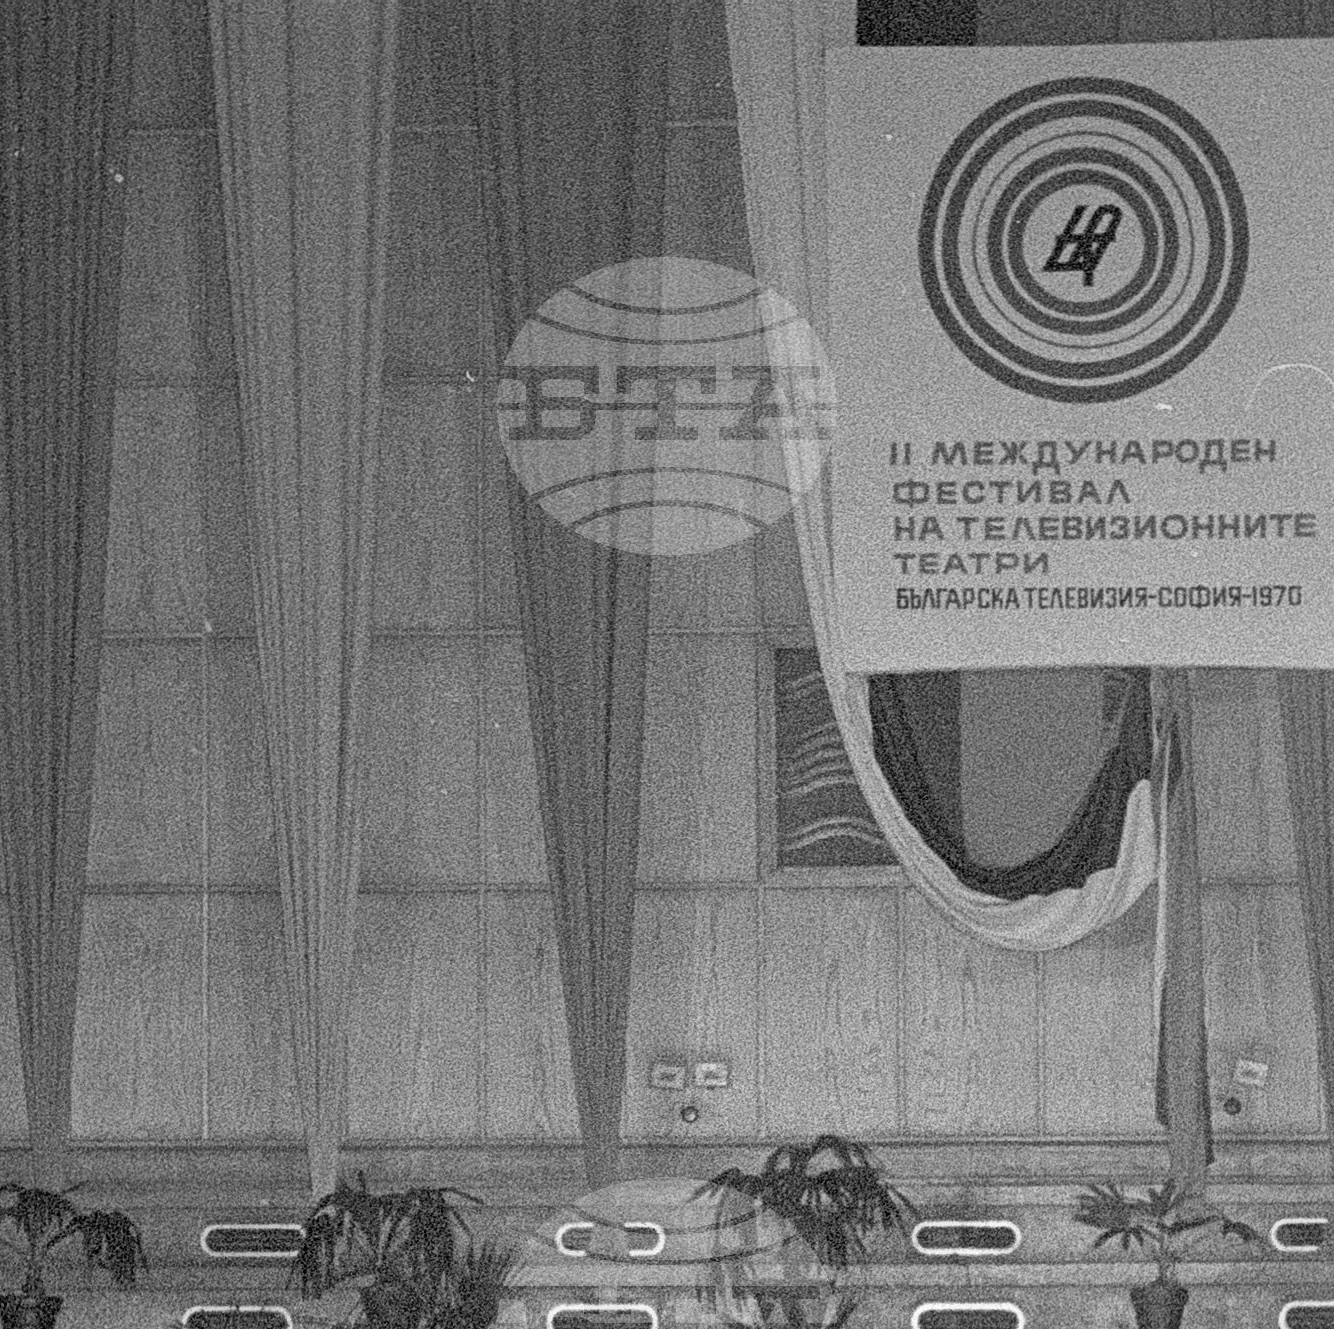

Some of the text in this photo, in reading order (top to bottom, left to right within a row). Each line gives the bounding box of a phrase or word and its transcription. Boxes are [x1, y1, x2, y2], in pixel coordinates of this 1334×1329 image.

[931, 438, 1276, 476] МЕЖДУНАРОДЕН
[892, 479, 1132, 508] ФЕСТИВАЛ
[893, 513, 1317, 541] НА ТЕЛЕВИЗИОННИТЕ
[893, 552, 1050, 575] ТЕАТРИ
